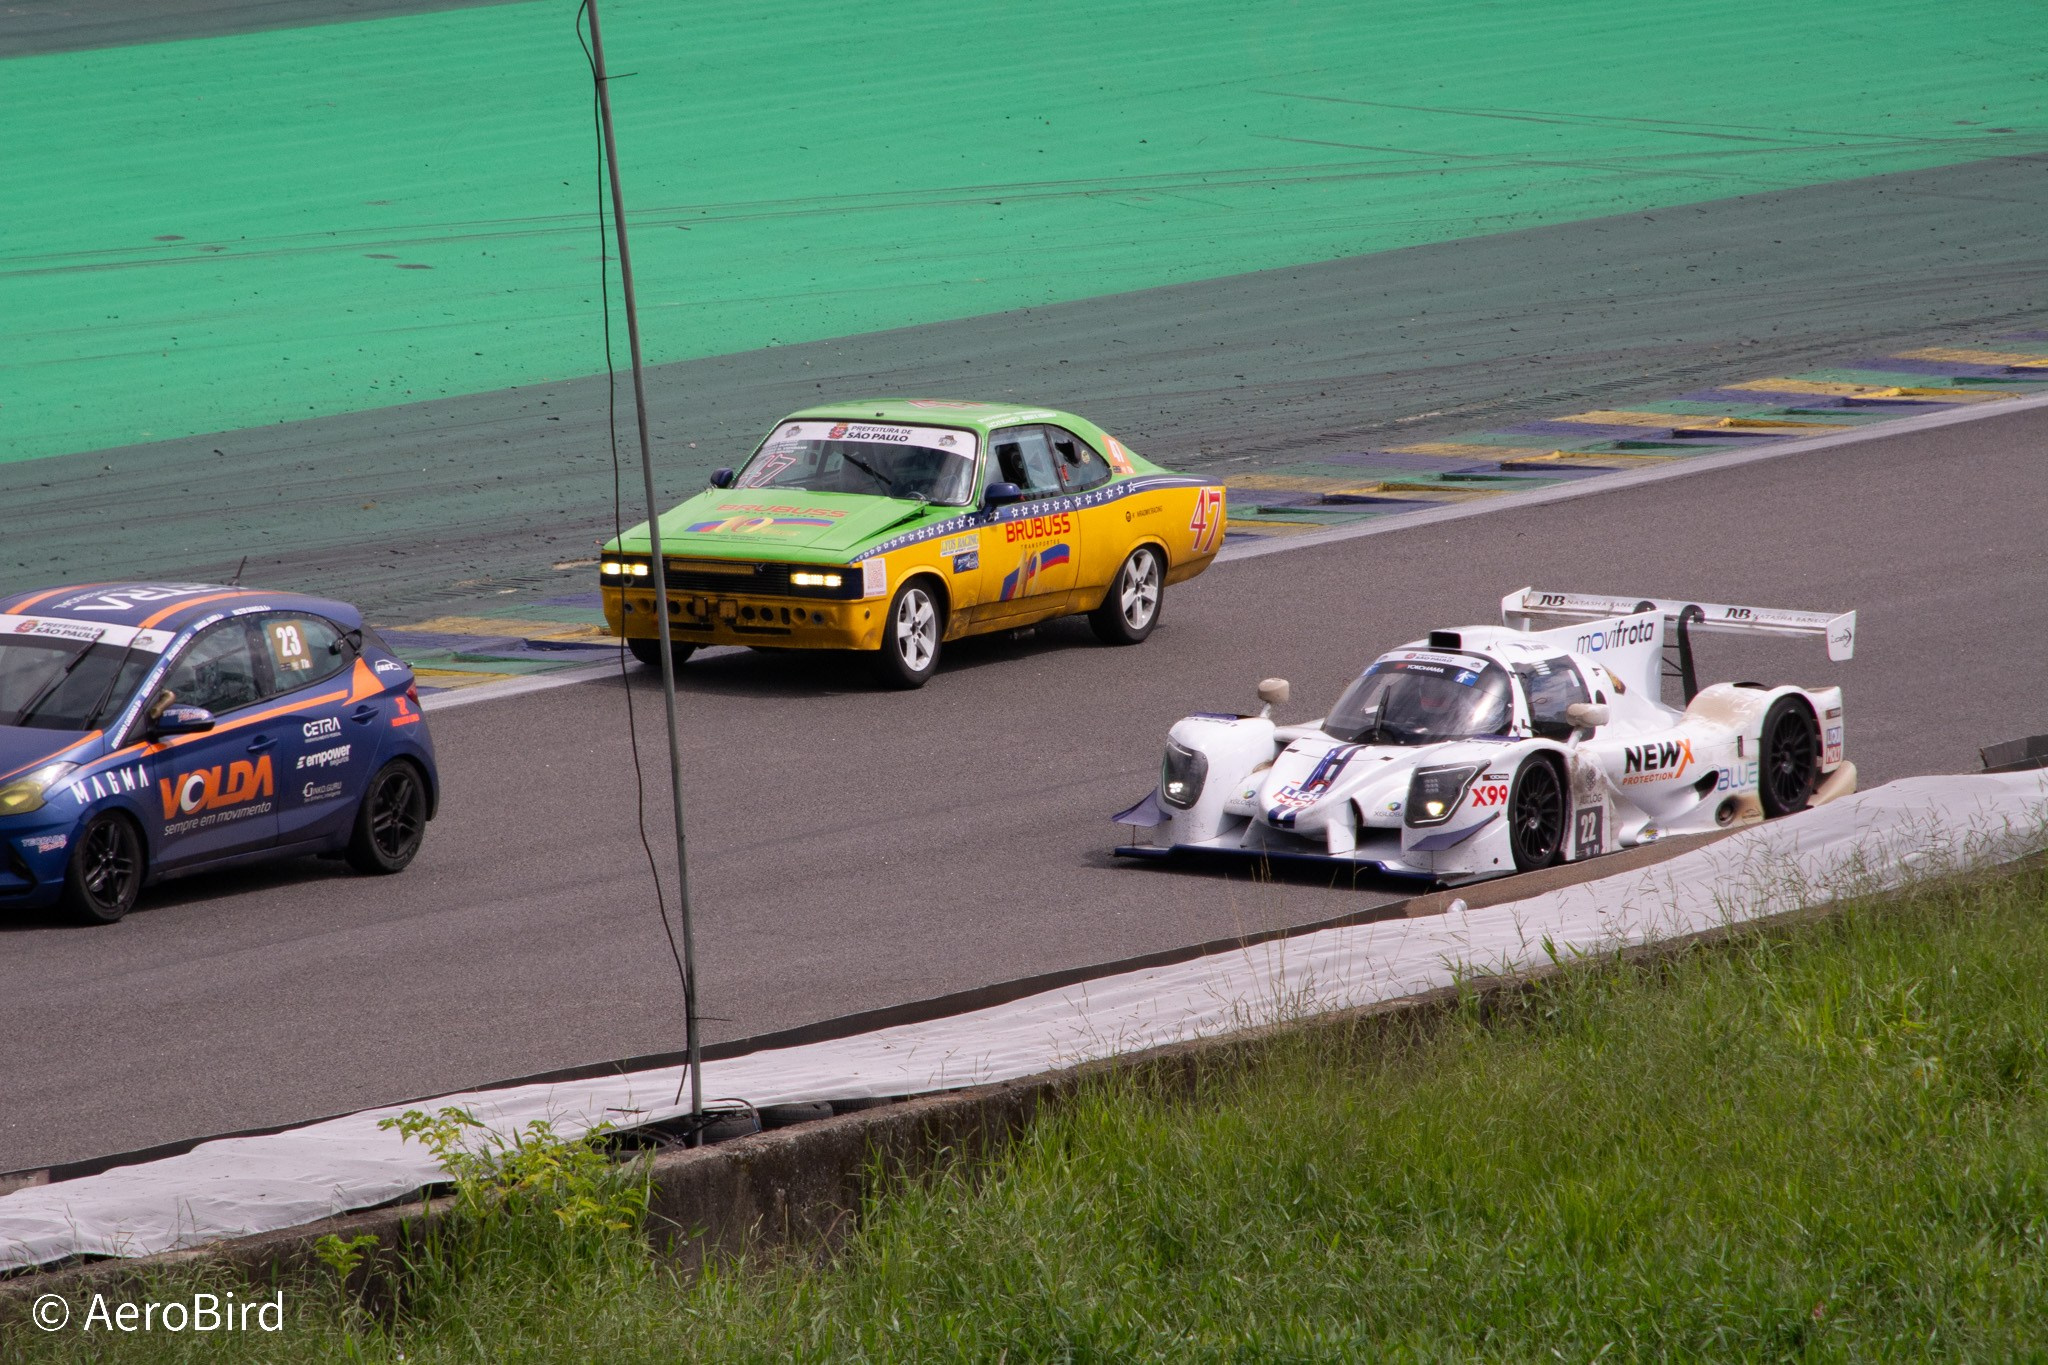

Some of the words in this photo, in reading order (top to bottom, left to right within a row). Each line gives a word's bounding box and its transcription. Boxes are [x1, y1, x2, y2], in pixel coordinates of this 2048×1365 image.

[846, 432, 870, 440] SÃO
[871, 432, 909, 442] PAULO
[852, 425, 897, 435] PREFEITURA
[716, 504, 849, 518] BRUBUSS
[1189, 486, 1222, 553] 47
[1006, 512, 1071, 543] BRUBUSS
[1566, 599, 1607, 607] NATASHA
[34, 626, 59, 636] SÃO
[41, 622, 92, 632] PREFEITURA
[276, 625, 302, 657] 23
[1407, 664, 1444, 674] YOKOHAMA
[303, 717, 341, 738] CETRA
[306, 744, 351, 767] empower
[70, 764, 150, 805] MAGMA
[159, 755, 274, 820] VOLDA
[1622, 772, 1673, 786] PROTECTION
[1471, 784, 1508, 807] X99
[164, 818, 199, 836] sempre
[200, 813, 216, 826] em
[217, 801, 272, 821] movimento
[1580, 811, 1597, 844] 22
